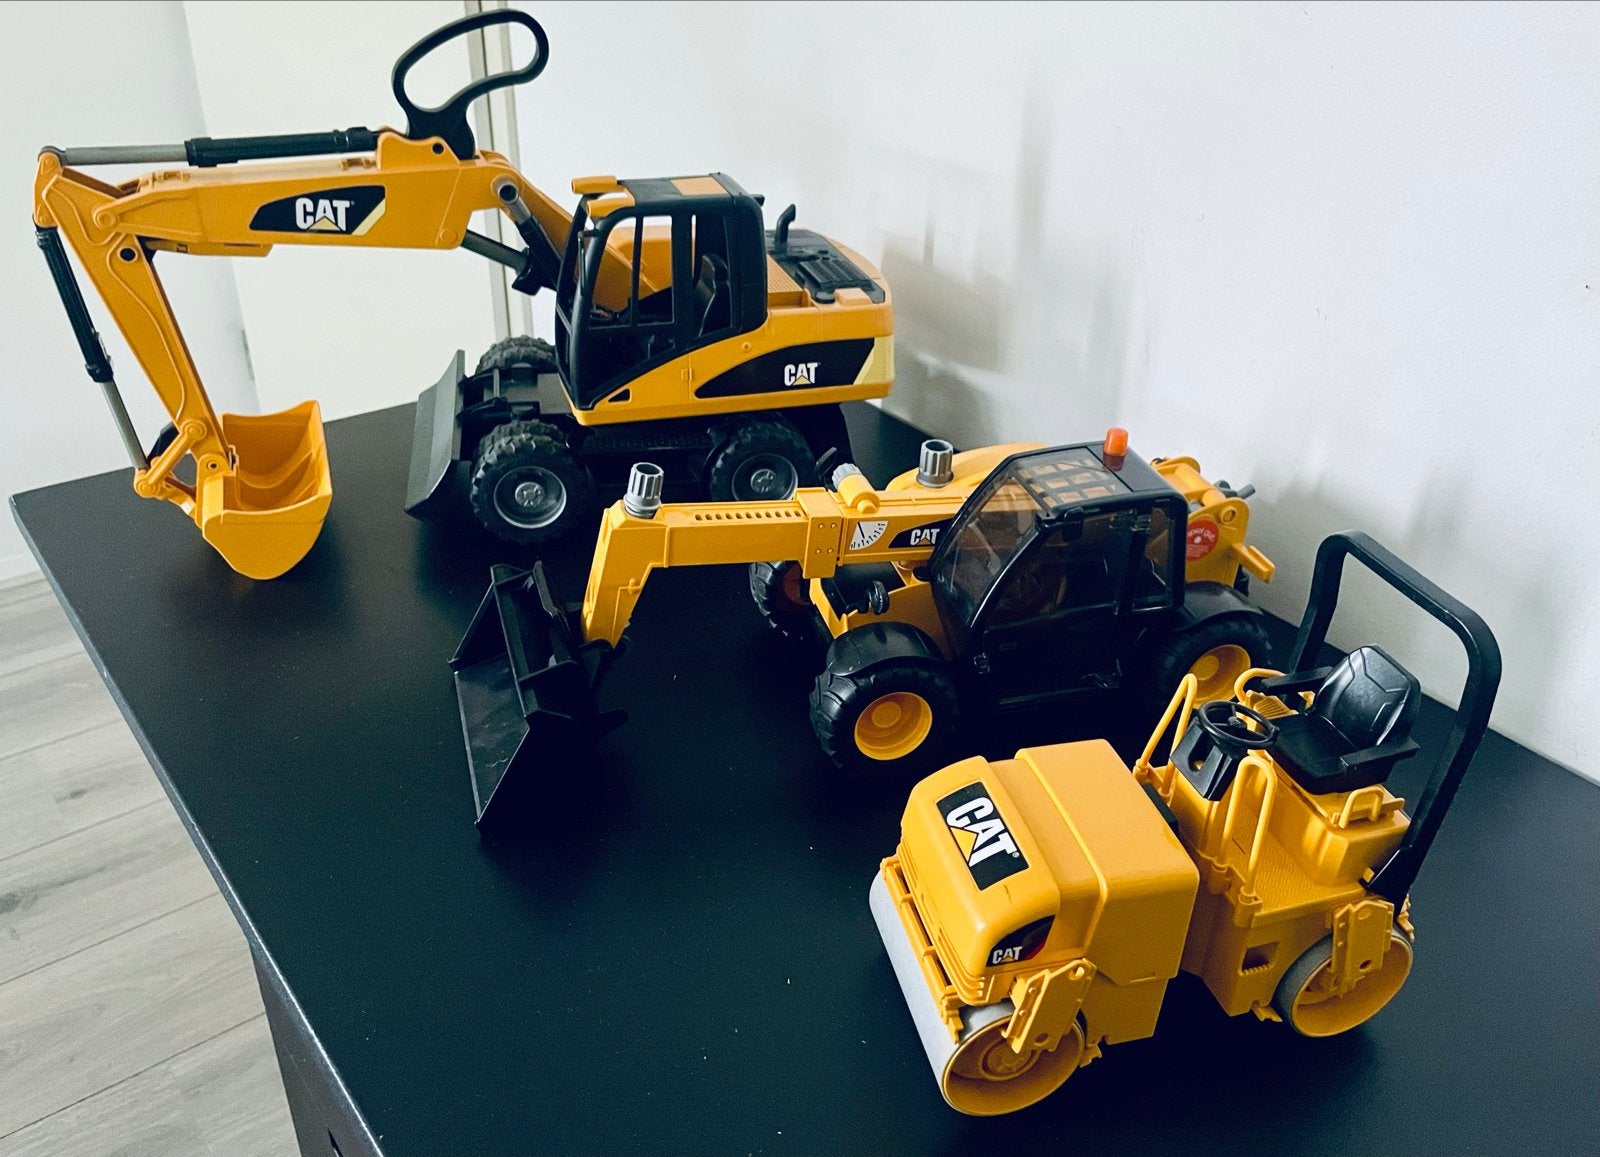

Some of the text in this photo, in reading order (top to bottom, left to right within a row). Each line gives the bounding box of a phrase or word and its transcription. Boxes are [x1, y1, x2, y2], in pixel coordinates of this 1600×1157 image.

[295, 197, 350, 231] CAT
[784, 362, 818, 386] CAT
[910, 528, 940, 546] CAT
[946, 797, 1018, 867] CAT
[992, 946, 1022, 964] CAT
